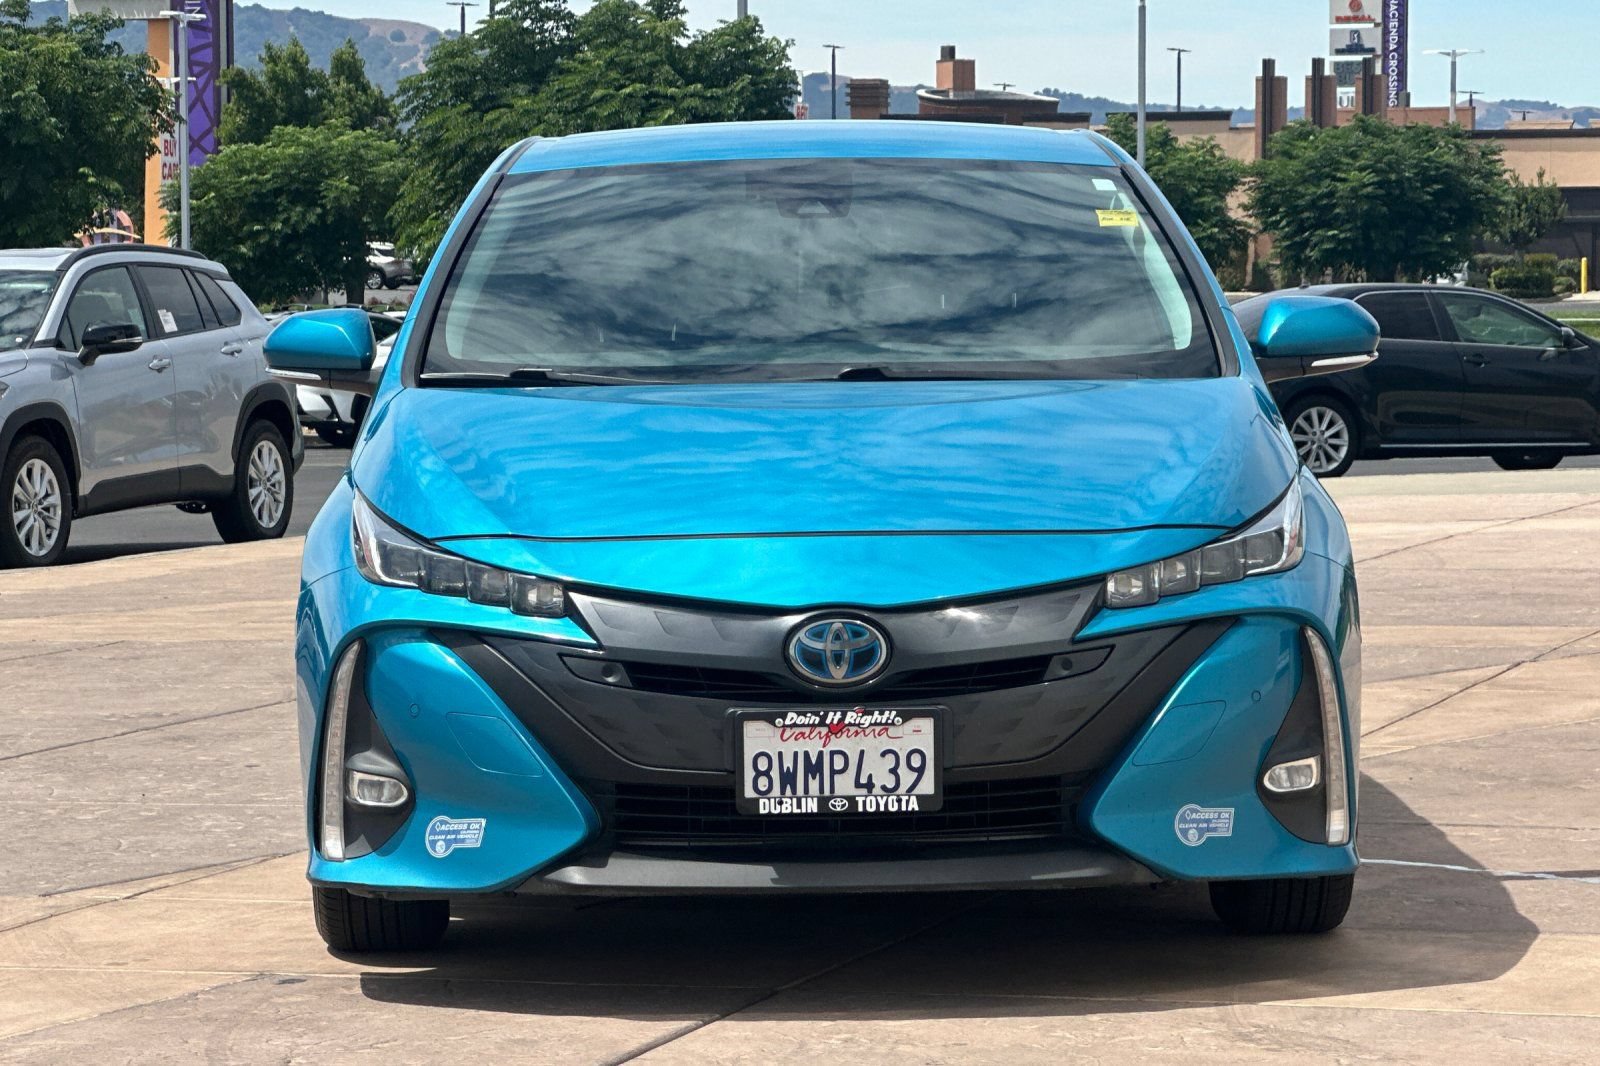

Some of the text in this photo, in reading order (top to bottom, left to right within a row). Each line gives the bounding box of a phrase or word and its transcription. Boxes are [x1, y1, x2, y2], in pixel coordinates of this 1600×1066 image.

[1388, 52, 1398, 107] CROSSING
[784, 710, 897, 728] Doin' It Right!
[779, 724, 904, 749] California
[752, 748, 927, 797] 8WMP439
[759, 795, 919, 815] DUBLIN TOYOTA
[440, 823, 468, 831] ACCESS
